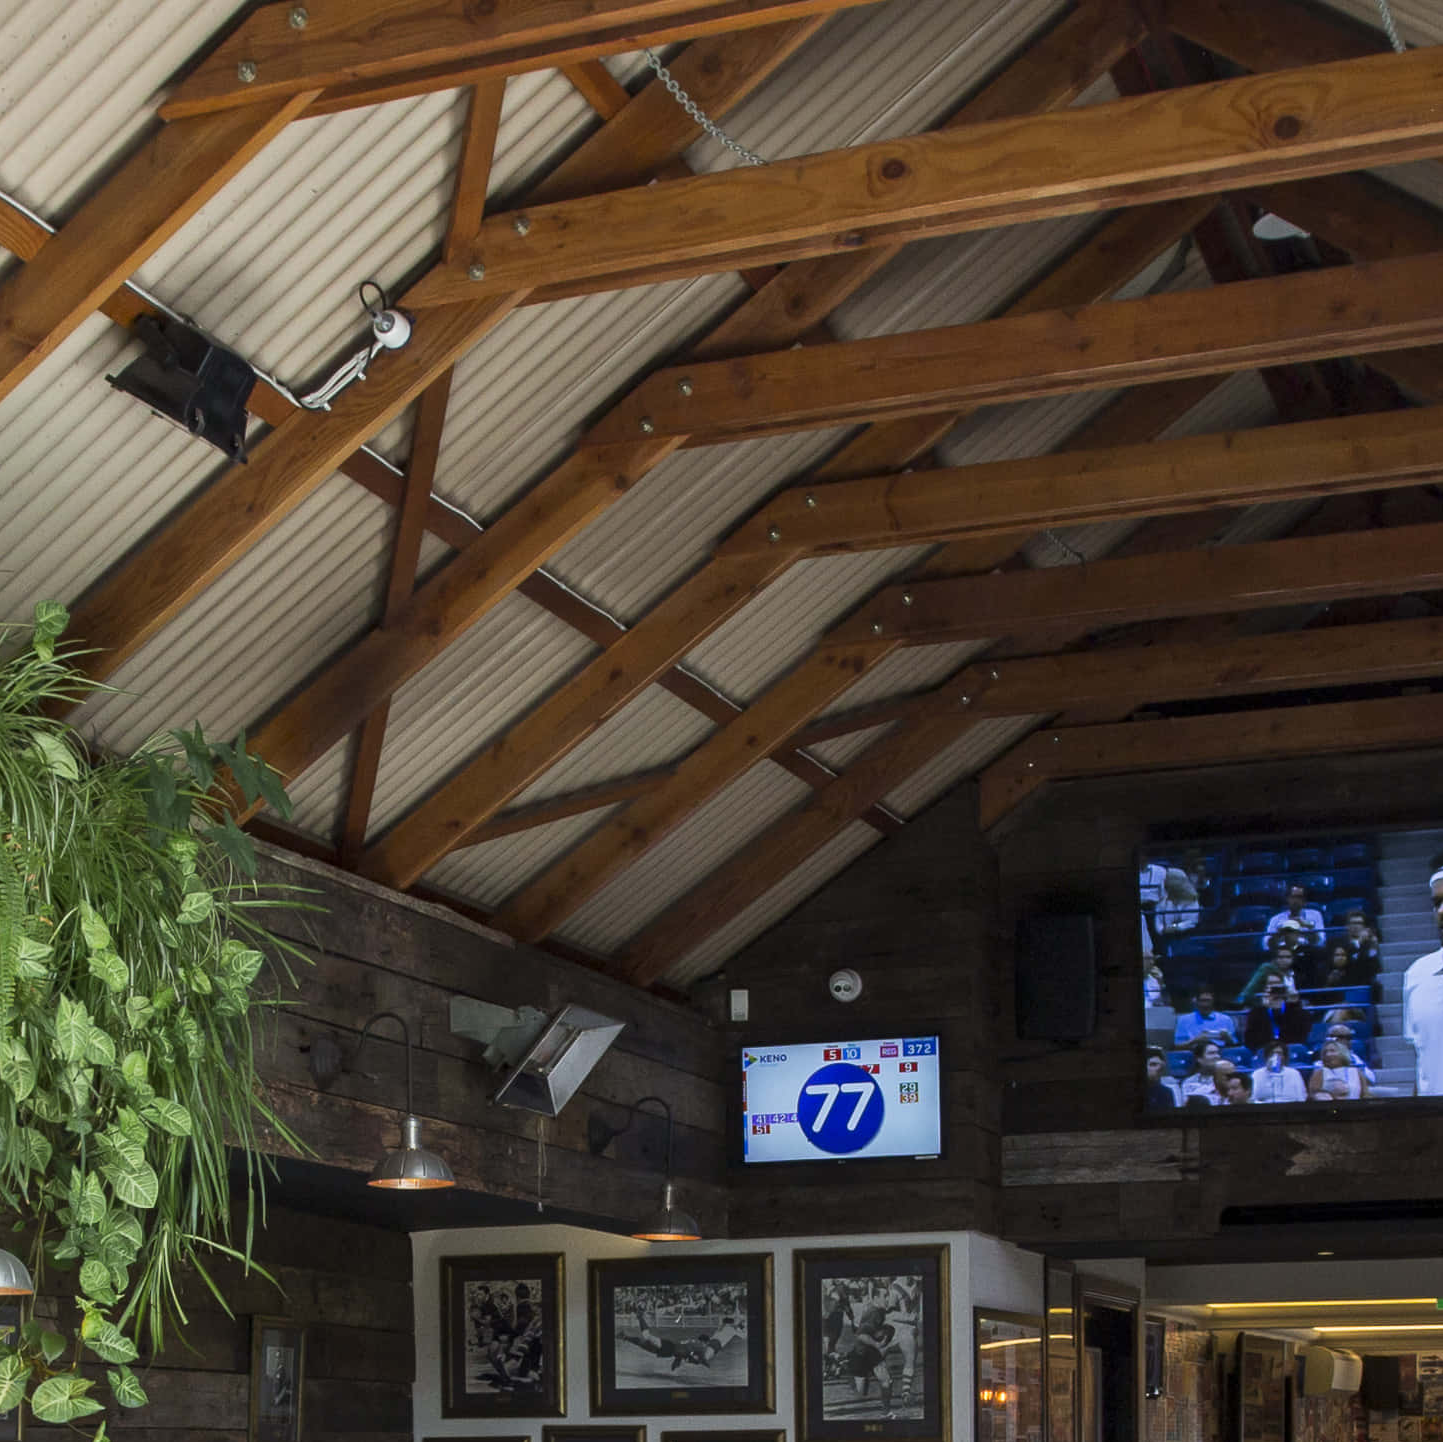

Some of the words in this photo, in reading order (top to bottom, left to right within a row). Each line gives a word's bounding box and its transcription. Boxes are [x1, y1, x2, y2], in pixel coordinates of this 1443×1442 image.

[846, 1049, 857, 1058] 10
[907, 1043, 932, 1055] 372
[759, 1054, 788, 1064] KENO
[829, 1050, 837, 1059] 5
[903, 1063, 912, 1072] 9
[901, 1083, 917, 1093] 29
[901, 1093, 917, 1103] 39
[805, 1082, 875, 1134] 77
[756, 1115, 767, 1124] 41
[772, 1115, 786, 1124] 42
[756, 1126, 767, 1134] 51
